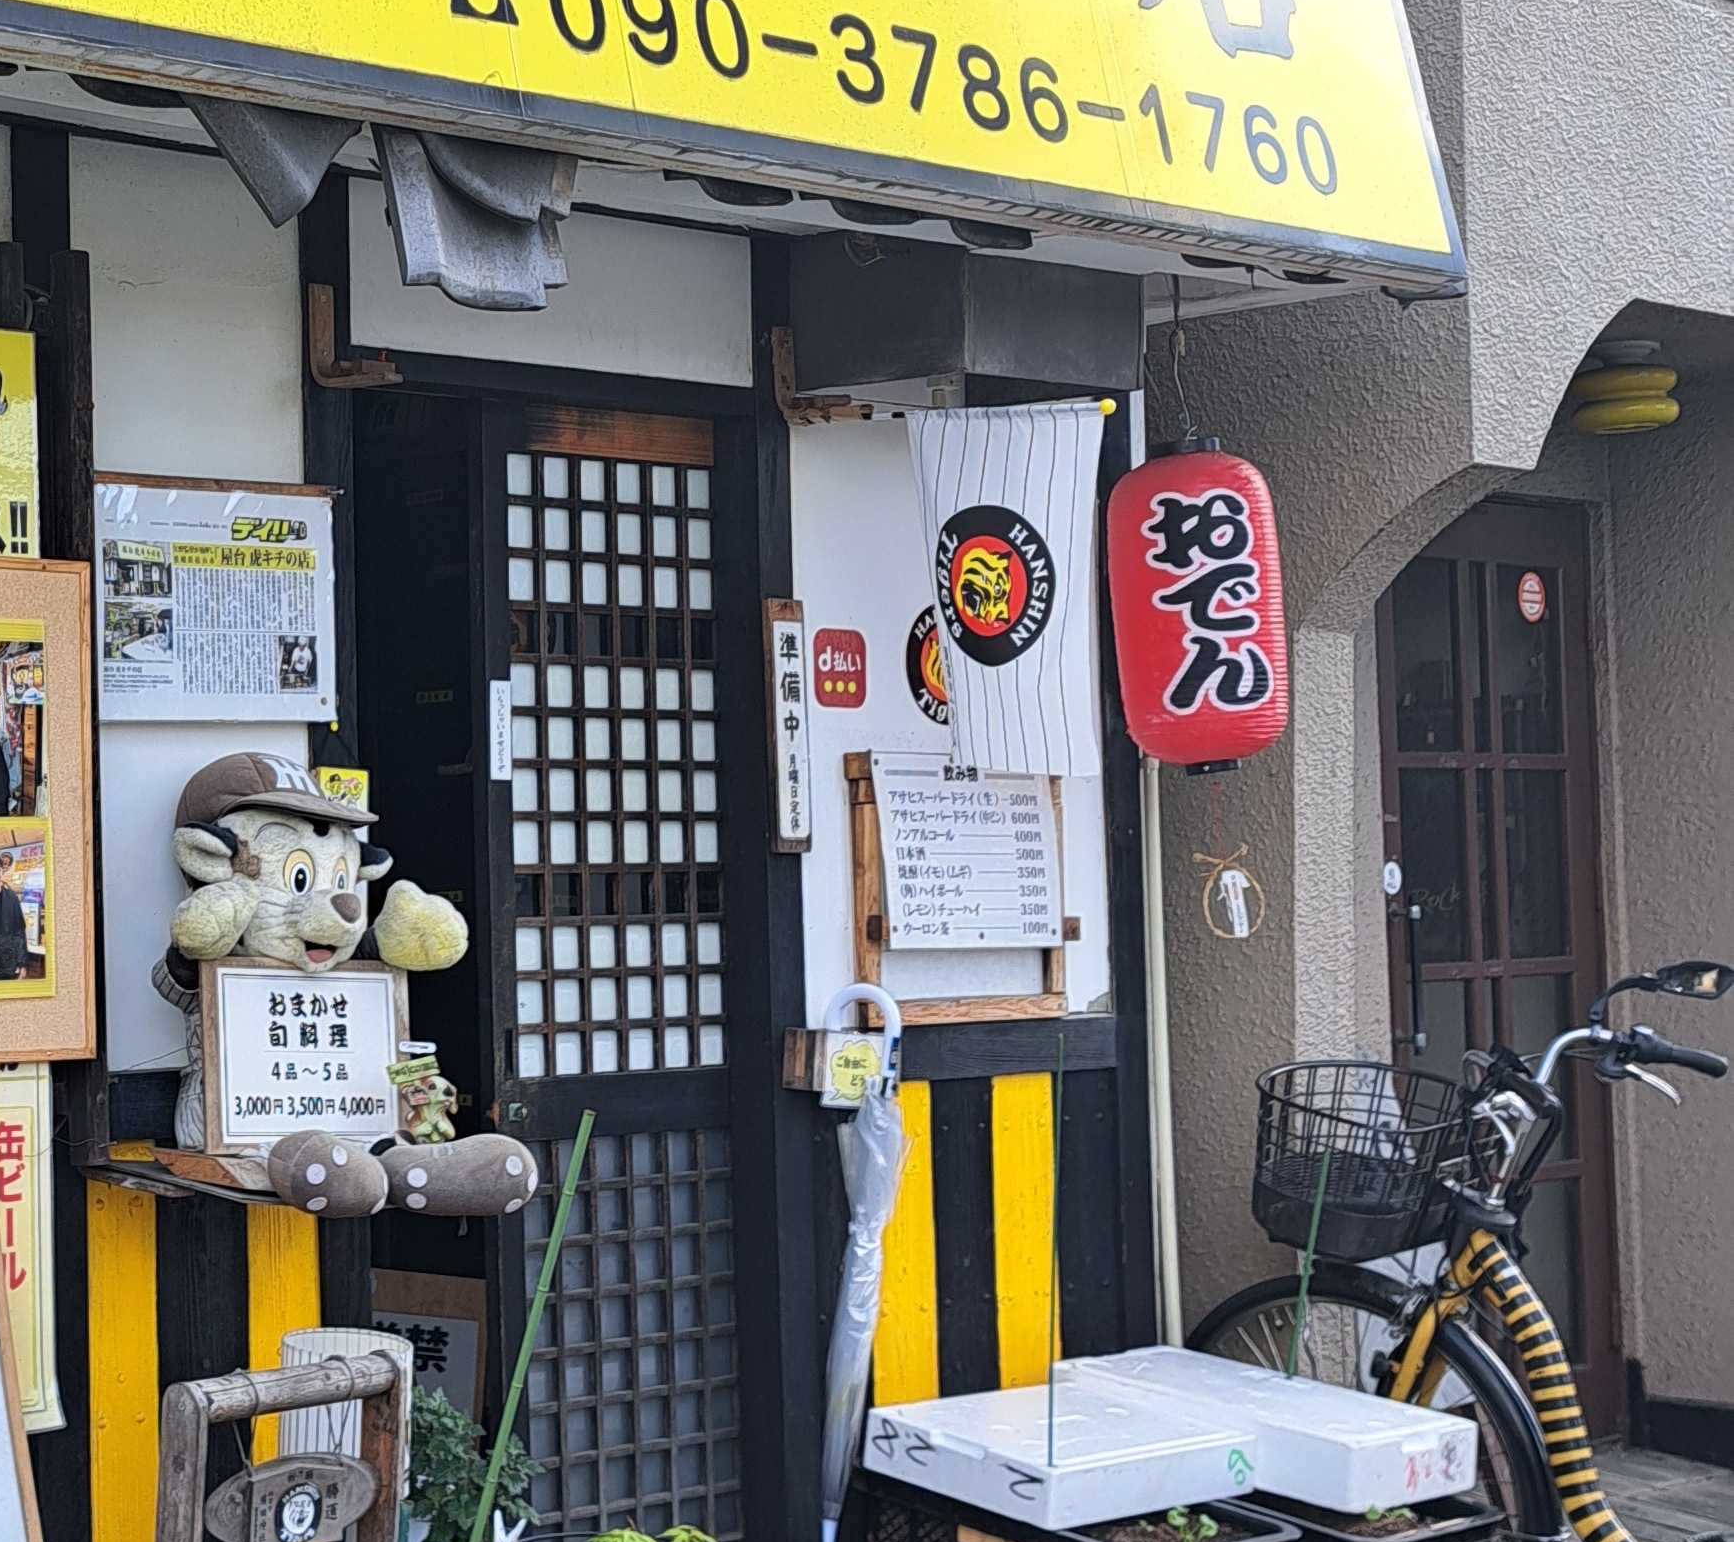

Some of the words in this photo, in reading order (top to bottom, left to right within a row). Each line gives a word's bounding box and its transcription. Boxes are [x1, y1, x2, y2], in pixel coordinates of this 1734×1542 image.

[1008, 522, 1049, 648] HANSHIN
[1148, 495, 1270, 709] おでん
[818, 646, 861, 672] d払い
[779, 632, 801, 742] 準備中
[943, 765, 978, 782] 飲み物
[1009, 794, 1038, 806] 500円
[894, 829, 955, 841] ノンアルコール
[896, 847, 926, 860] 日本酒
[1016, 849, 1044, 860] 500円
[1018, 867, 1045, 879] 350円
[1020, 885, 1047, 897] 350円
[1020, 904, 1048, 915] 350円
[903, 923, 950, 936] ウーロン茶
[269, 992, 349, 1018] おまかせ
[269, 1021, 349, 1048] 旬料理
[234, 1096, 283, 1119] 3,000円
[288, 1096, 335, 1119] 3,500円
[338, 1096, 386, 1118] 4,000円
